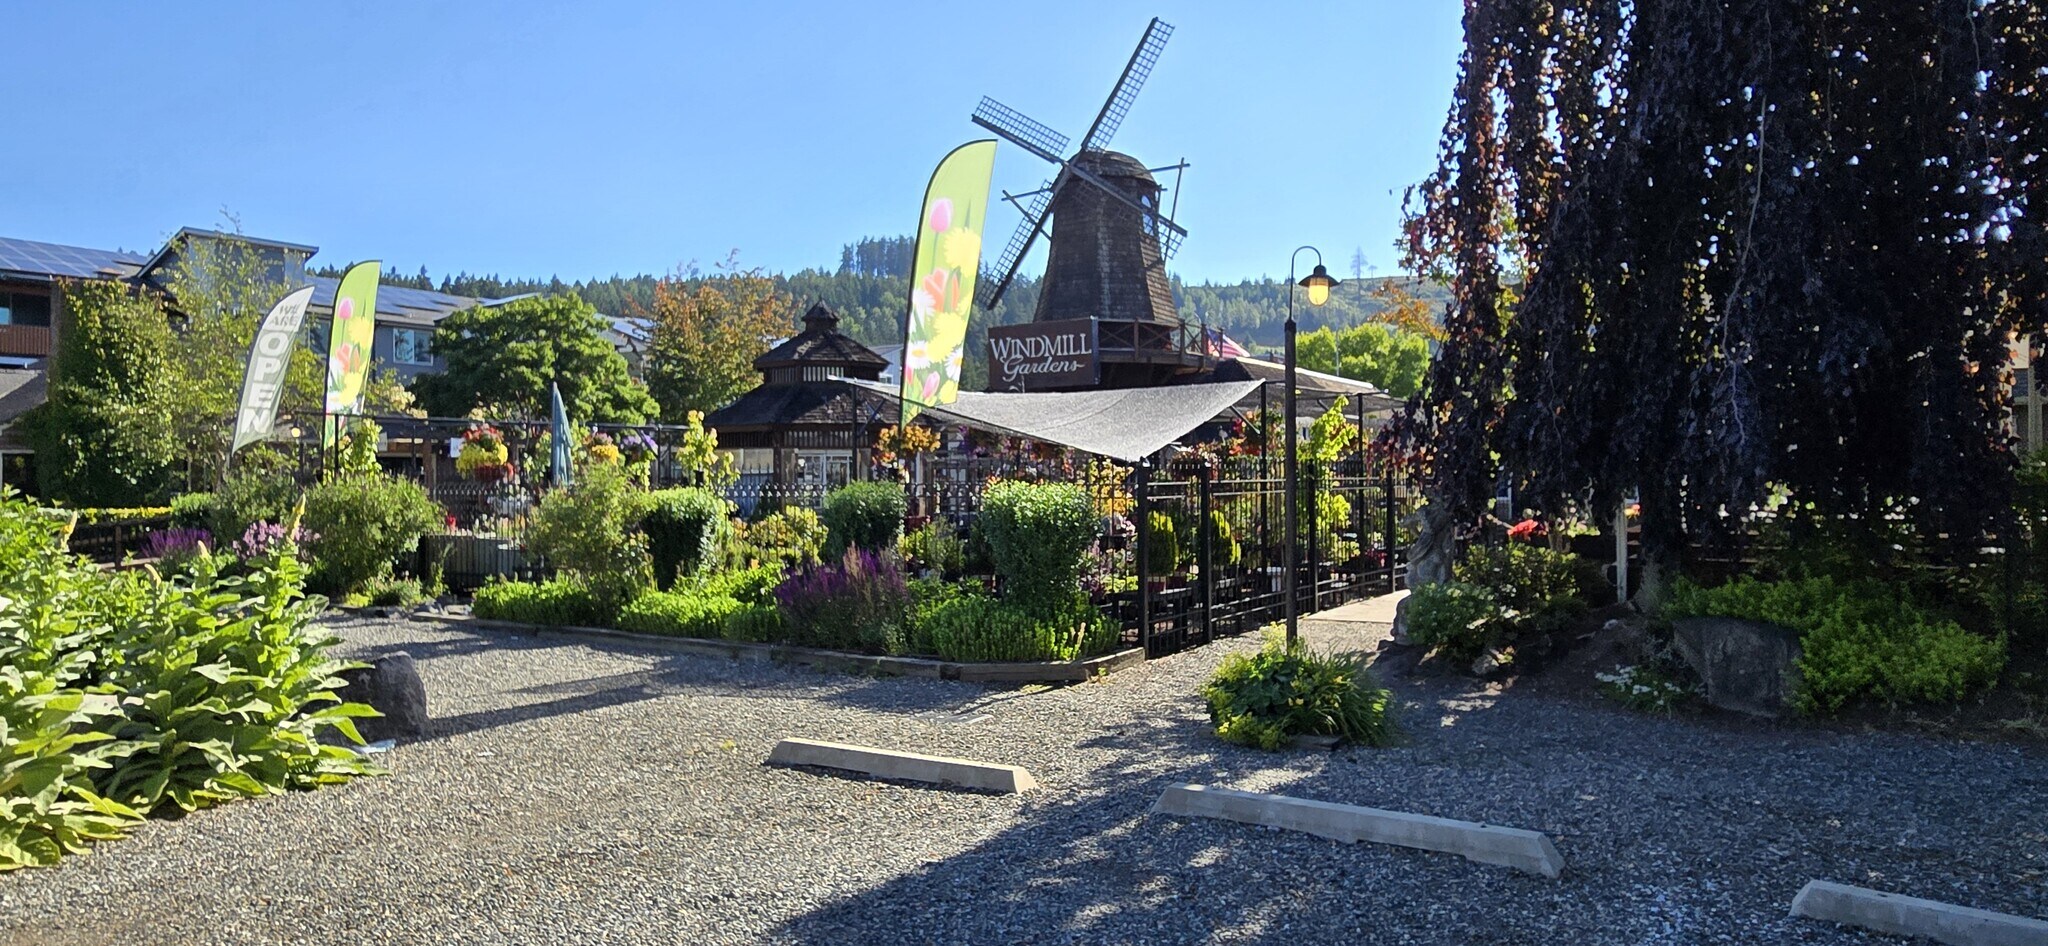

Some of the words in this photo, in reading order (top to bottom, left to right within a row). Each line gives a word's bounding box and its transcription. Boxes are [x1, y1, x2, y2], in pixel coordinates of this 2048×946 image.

[269, 315, 299, 327] ARE
[990, 333, 1092, 360] WINDMILL
[1000, 355, 1085, 382] Gardens
[240, 332, 289, 434] OPEN
